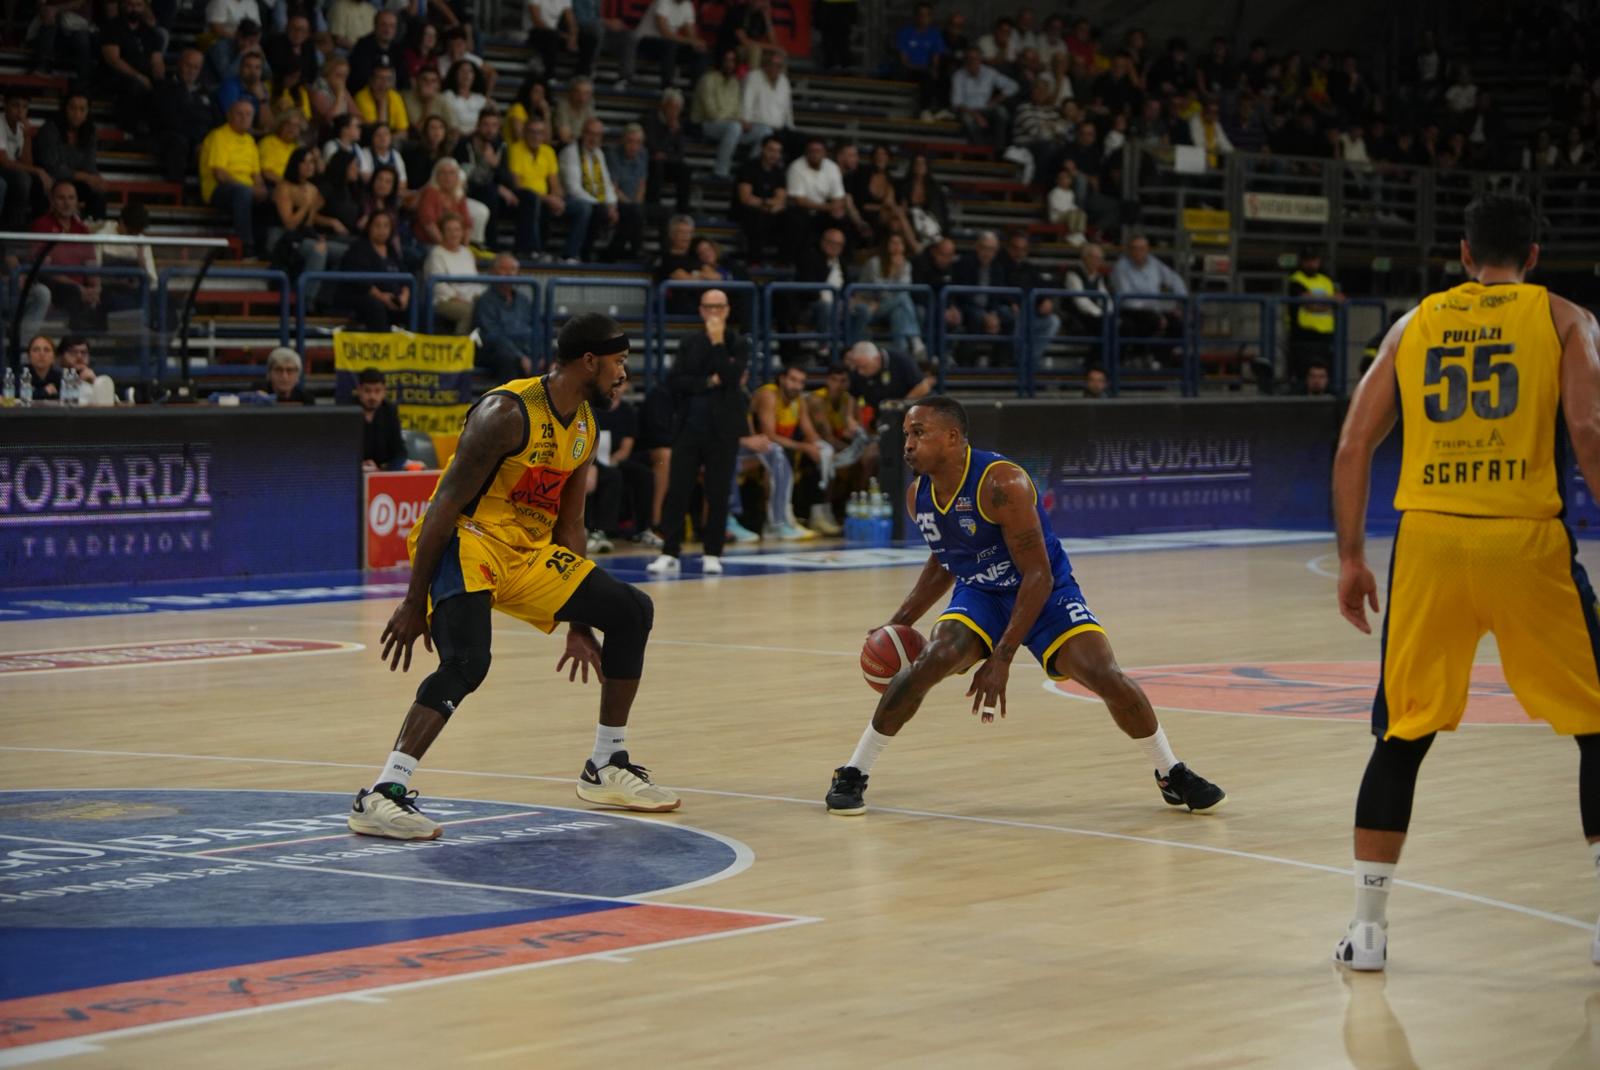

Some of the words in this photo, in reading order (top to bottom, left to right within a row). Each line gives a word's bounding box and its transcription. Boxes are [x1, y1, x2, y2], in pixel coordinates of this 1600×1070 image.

[1443, 326, 1502, 343] PULLAZI
[1423, 344, 1519, 423] 55
[541, 423, 554, 438] 25
[1423, 459, 1526, 485] SCAFATI
[546, 550, 576, 574] 25
